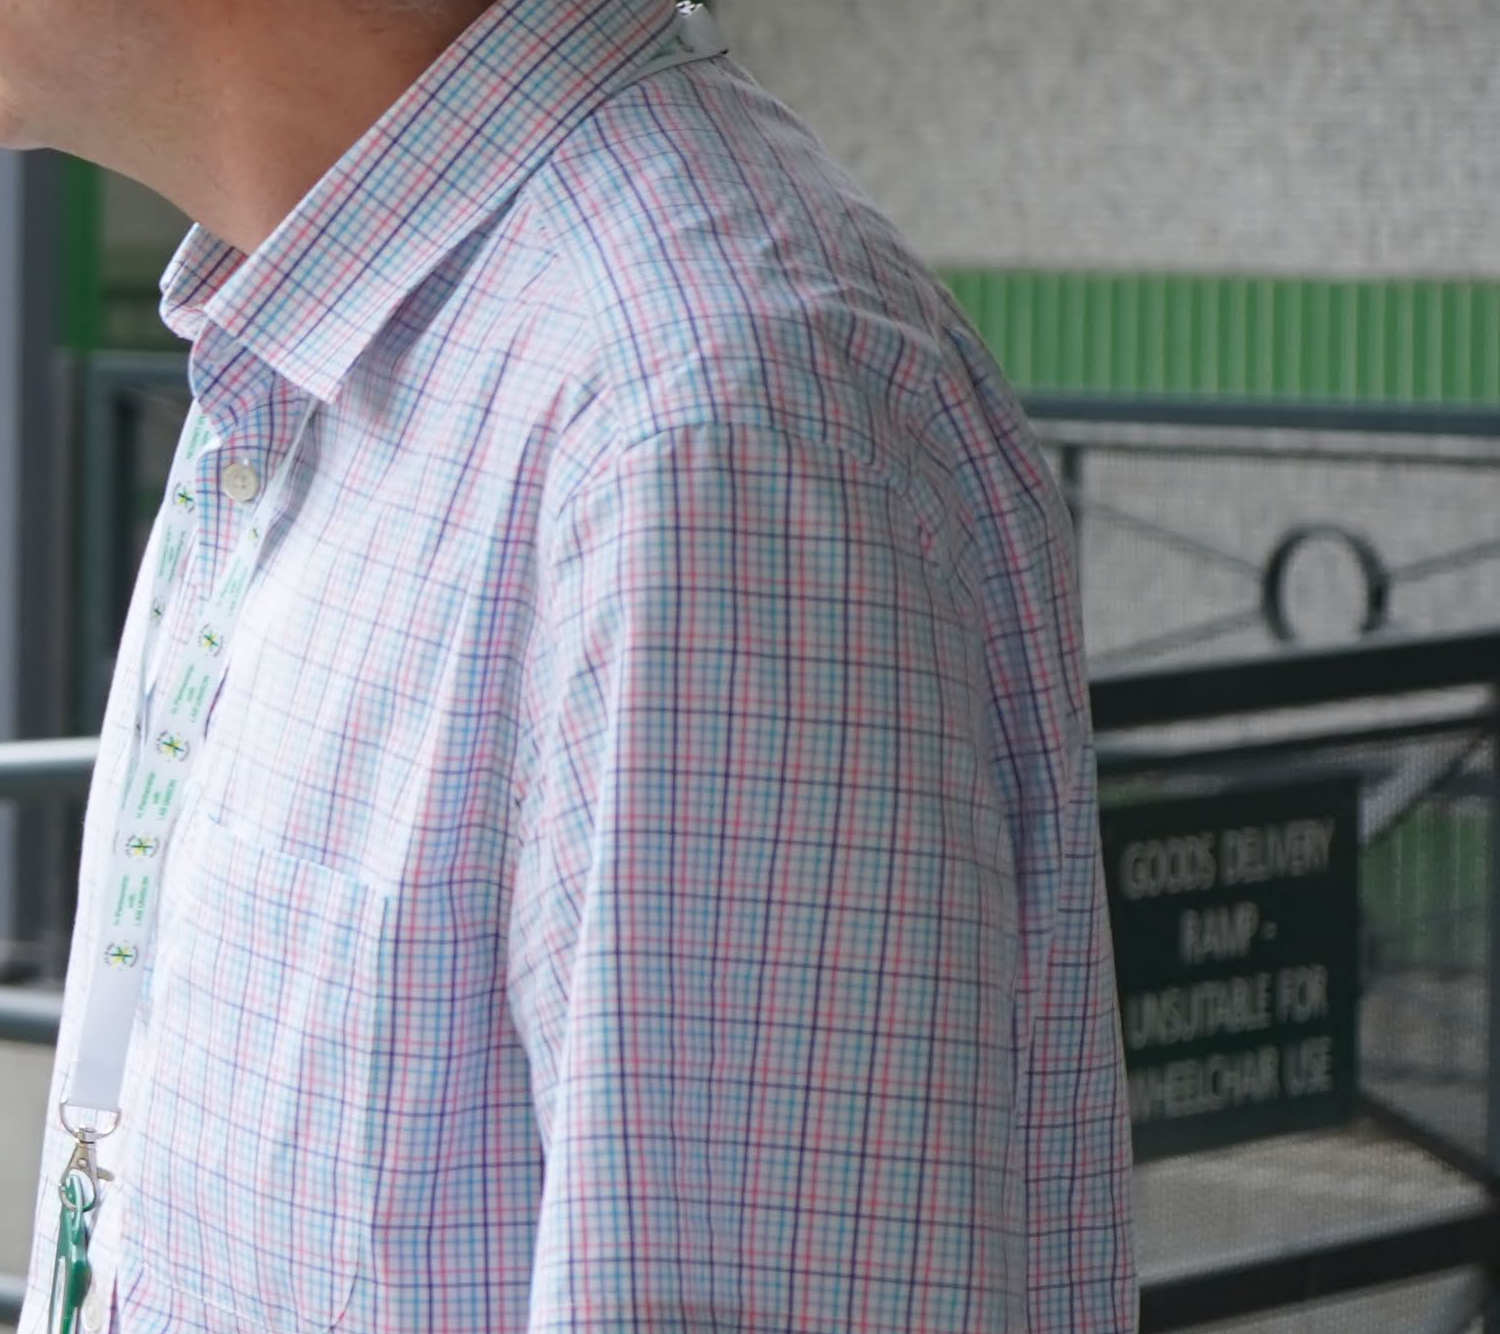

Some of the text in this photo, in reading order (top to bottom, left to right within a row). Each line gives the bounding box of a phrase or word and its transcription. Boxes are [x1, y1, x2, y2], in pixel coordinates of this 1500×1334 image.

[1120, 819, 1334, 900] GOODS DELIVERY
[1180, 901, 1259, 964] RAMP
[1128, 964, 1328, 1050] UNSUITABLE FOR
[1129, 1035, 1333, 1123] WHEELCHAIR USE
